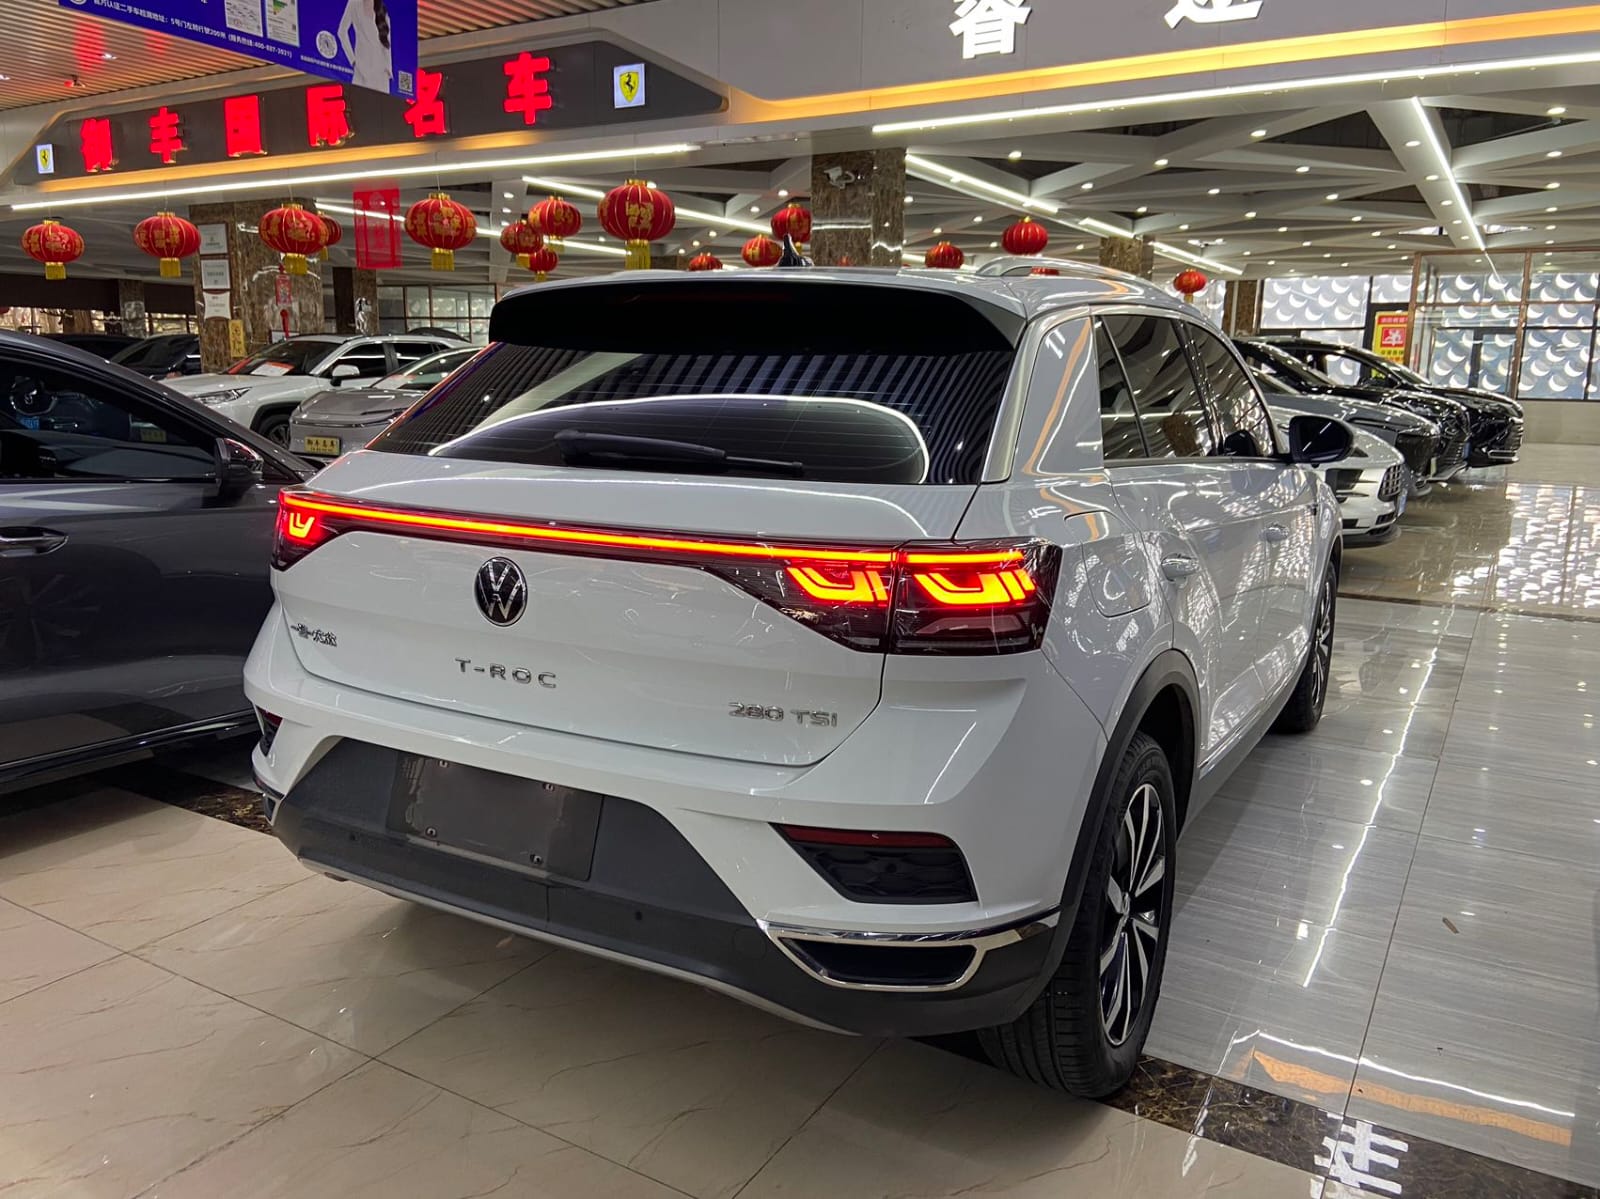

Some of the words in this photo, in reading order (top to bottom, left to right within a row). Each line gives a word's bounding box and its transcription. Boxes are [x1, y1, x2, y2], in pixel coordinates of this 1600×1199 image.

[455, 658, 557, 689] T-ROC
[728, 702, 784, 722] 280
[790, 709, 837, 728] TSI
